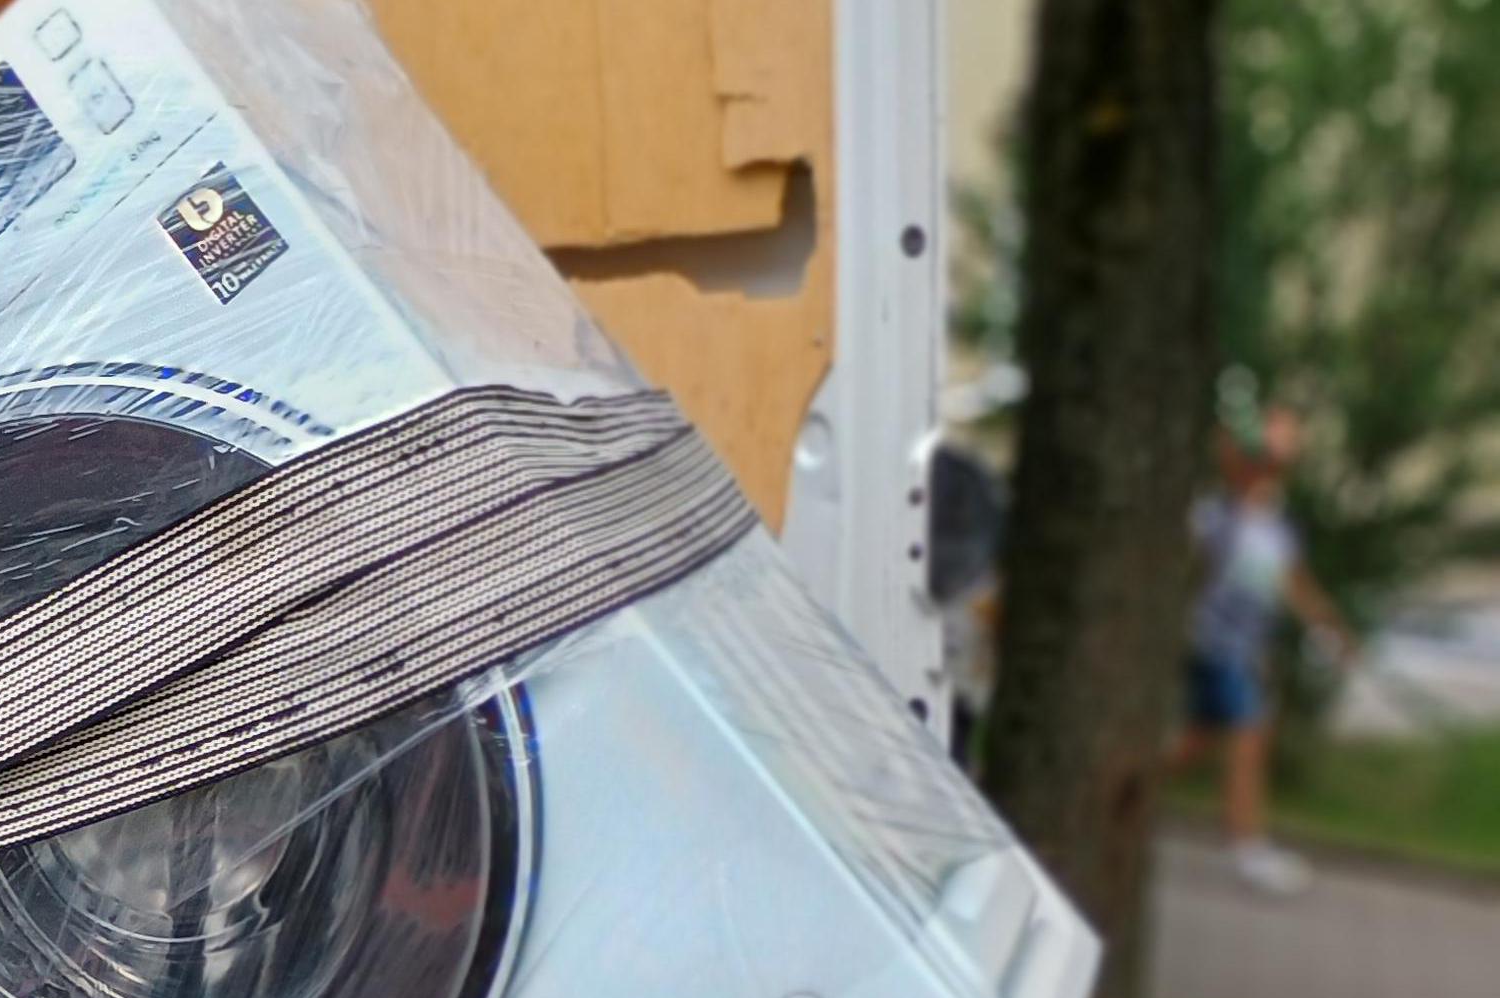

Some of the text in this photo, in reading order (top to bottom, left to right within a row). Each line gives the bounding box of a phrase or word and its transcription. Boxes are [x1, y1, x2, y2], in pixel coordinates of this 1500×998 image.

[197, 210, 245, 253] DIGITAL
[198, 214, 258, 268] INVERTER
[211, 272, 241, 298] 10
